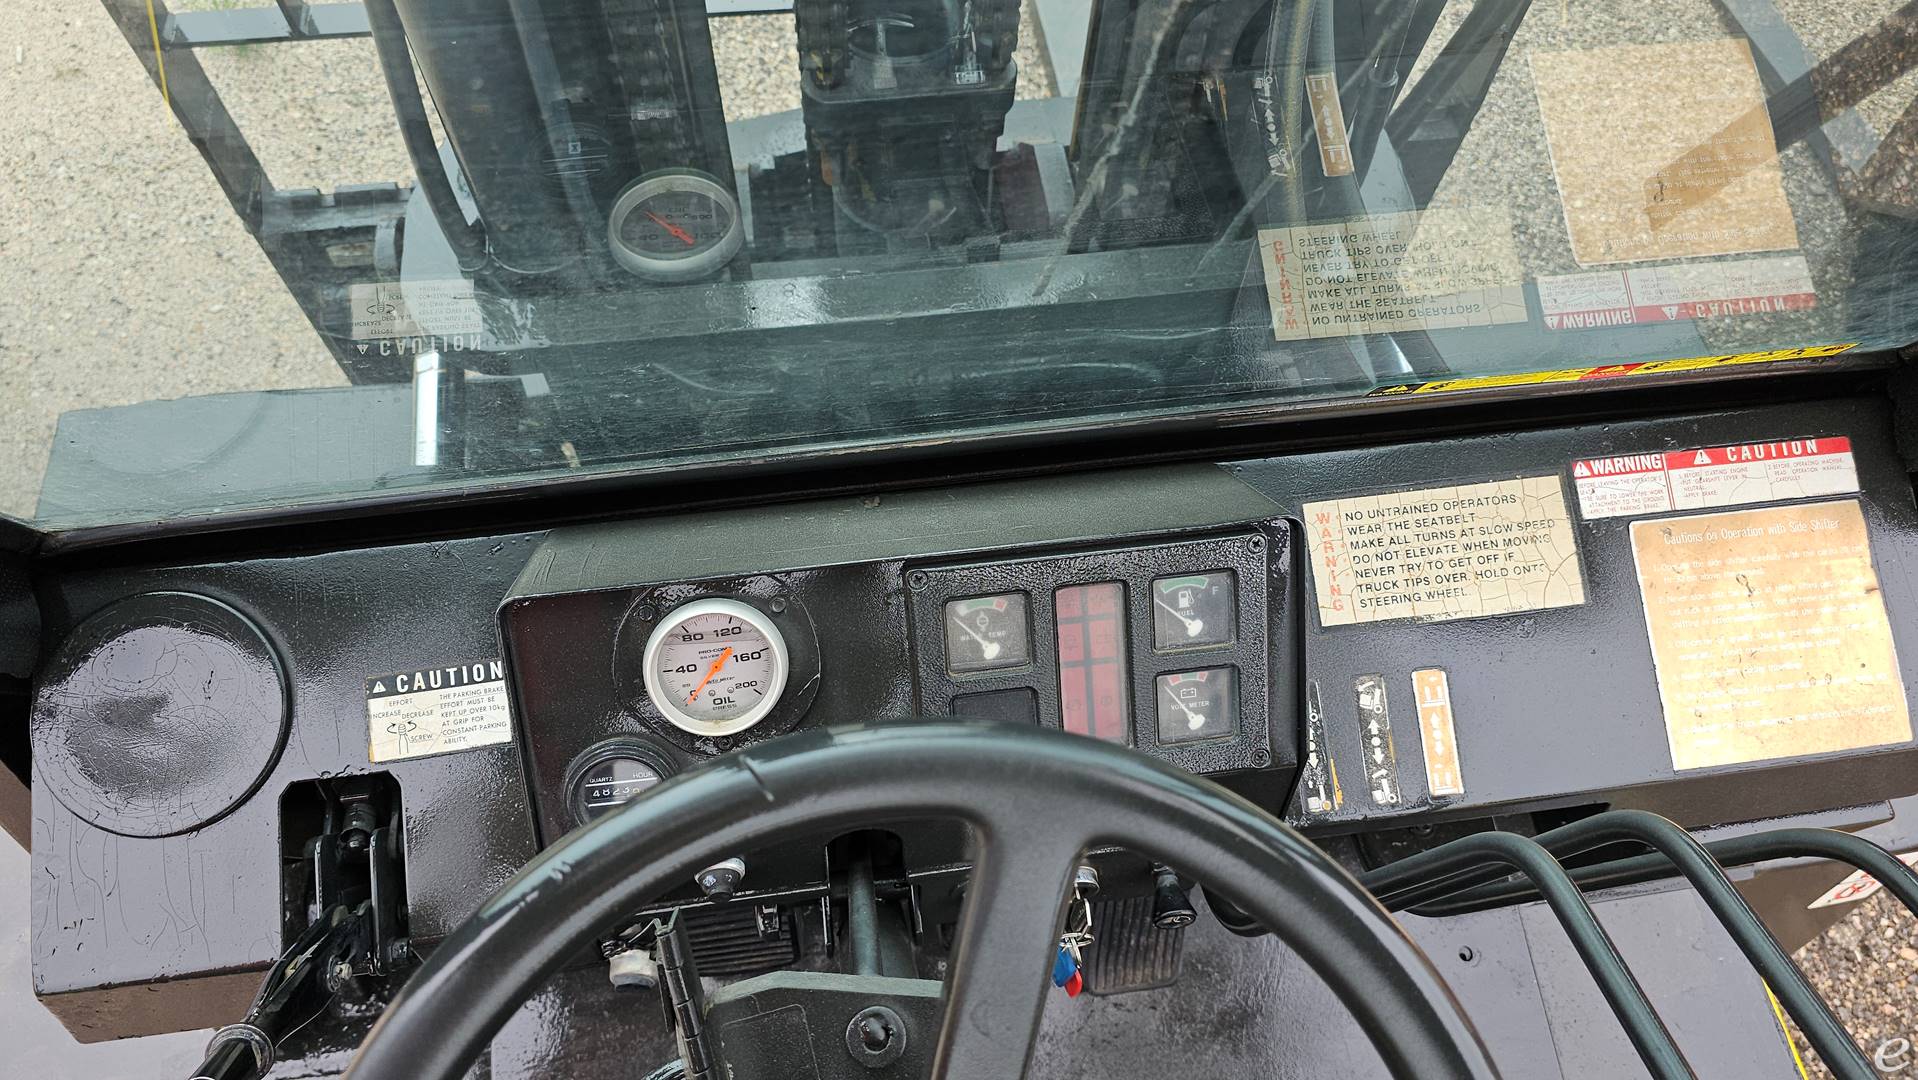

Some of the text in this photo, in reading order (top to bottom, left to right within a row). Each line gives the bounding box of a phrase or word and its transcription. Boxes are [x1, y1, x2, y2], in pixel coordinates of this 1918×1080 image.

[1727, 439, 1818, 462] CAUTION
[1590, 454, 1662, 475] WARNING
[1345, 494, 1516, 522] NO UNTRAINED OPERATORS
[1348, 513, 1476, 536] WEAR THE SEATBELT
[1350, 518, 1555, 550] MAKE ALL TURNS AT SLOW SPEED
[1664, 519, 1840, 545] Cautions on Operation with Side Shifter
[1353, 533, 1551, 565] DO NOT ELEVATE WHEN MOVING
[1355, 552, 1515, 579] NEVER TRY TO GET OFF IF
[1356, 580, 1399, 594] TRUCK
[1403, 576, 1430, 588] TIPS
[1435, 572, 1471, 586] OVER.
[1475, 567, 1509, 581] HOLD
[1212, 586, 1219, 595] F
[1360, 592, 1421, 609] STEERING
[682, 633, 704, 642] 80
[713, 626, 742, 638] 120
[733, 651, 762, 663] 160
[675, 664, 697, 674] 40
[396, 661, 503, 693] CAUTION
[735, 680, 758, 689] 200
[453, 690, 482, 698] PARKING
[484, 686, 504, 694] BRAKE
[389, 698, 412, 706] EFFORT
[713, 696, 735, 705] OIL
[402, 710, 433, 719] DECREASE
[470, 706, 487, 714] OVER
[442, 721, 506, 736] CONSTANT PARKING
[410, 734, 432, 743] SCREW
[589, 776, 613, 784] QUARTZ
